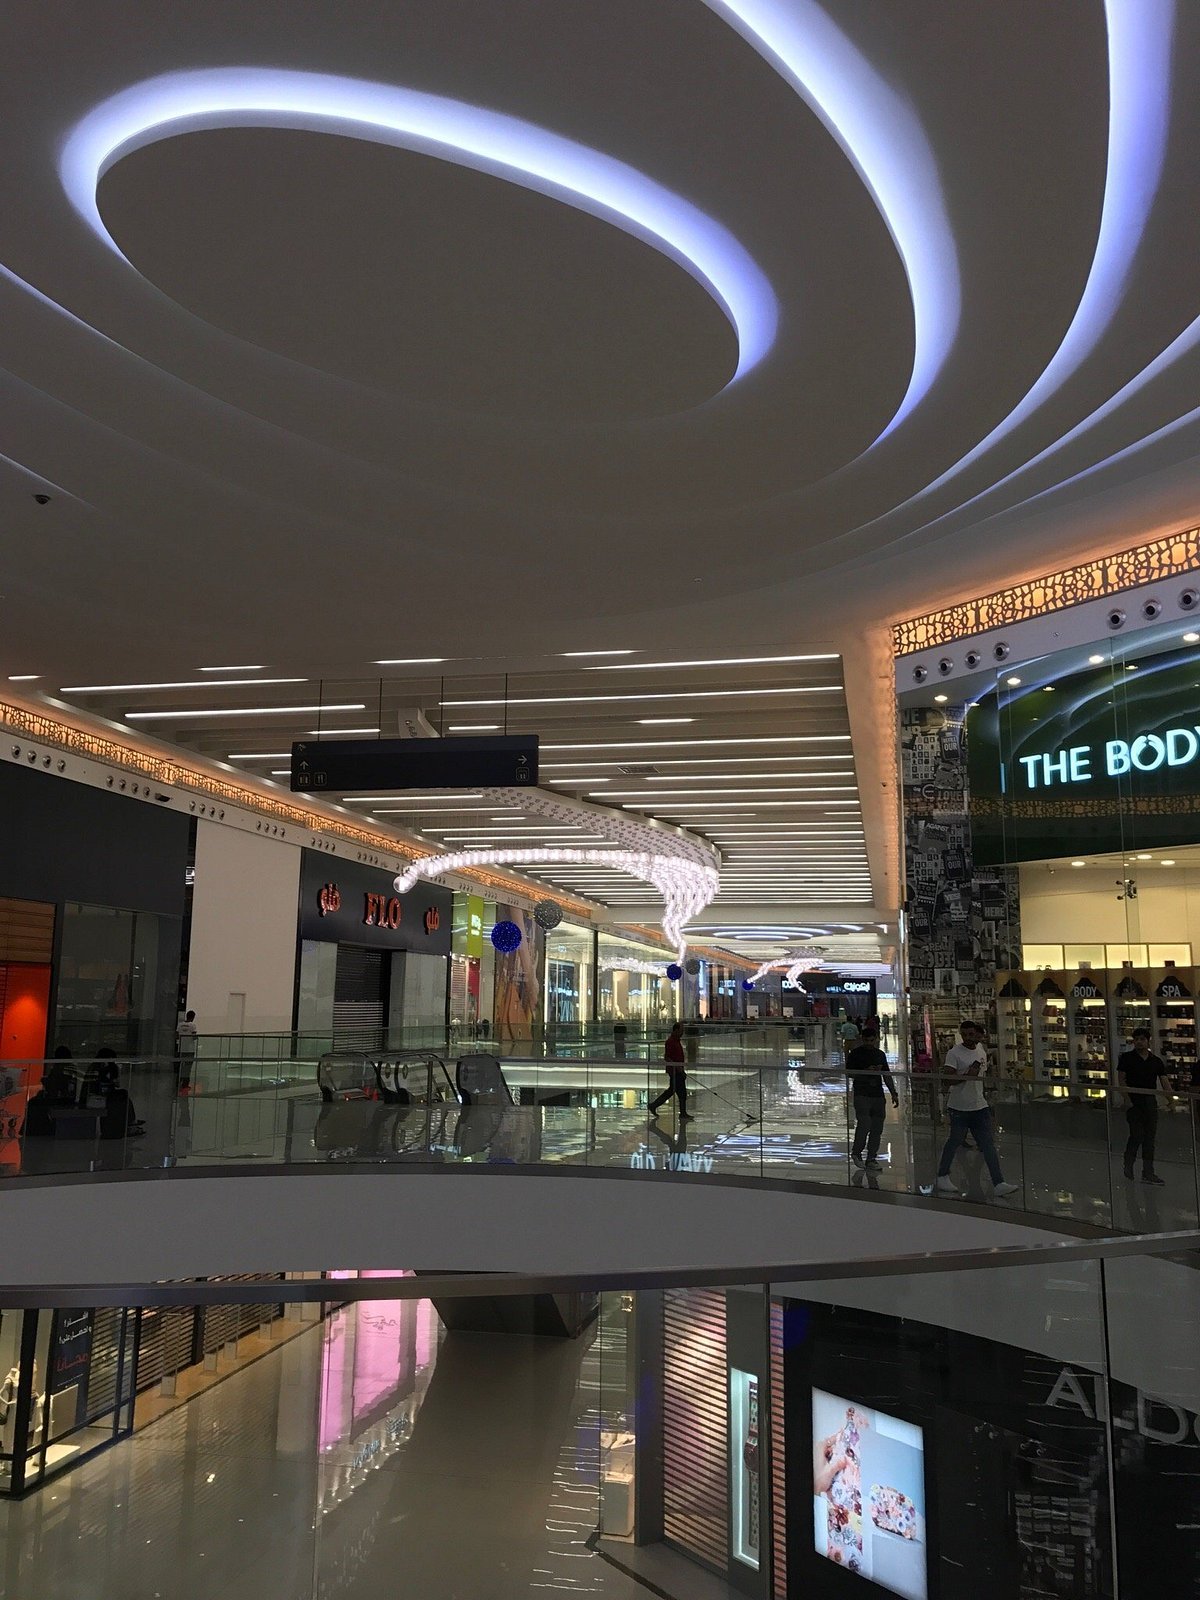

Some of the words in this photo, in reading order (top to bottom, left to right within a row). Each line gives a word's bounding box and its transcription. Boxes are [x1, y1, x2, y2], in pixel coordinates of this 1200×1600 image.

[943, 742, 958, 751] OUR
[1019, 746, 1092, 788] THE
[1106, 726, 1200, 776] BOD
[364, 892, 402, 930] FLO
[984, 907, 1005, 917] HERE
[1073, 985, 1098, 998] BODY
[1161, 984, 1181, 997] SPA
[1045, 1365, 1200, 1443] ALD
